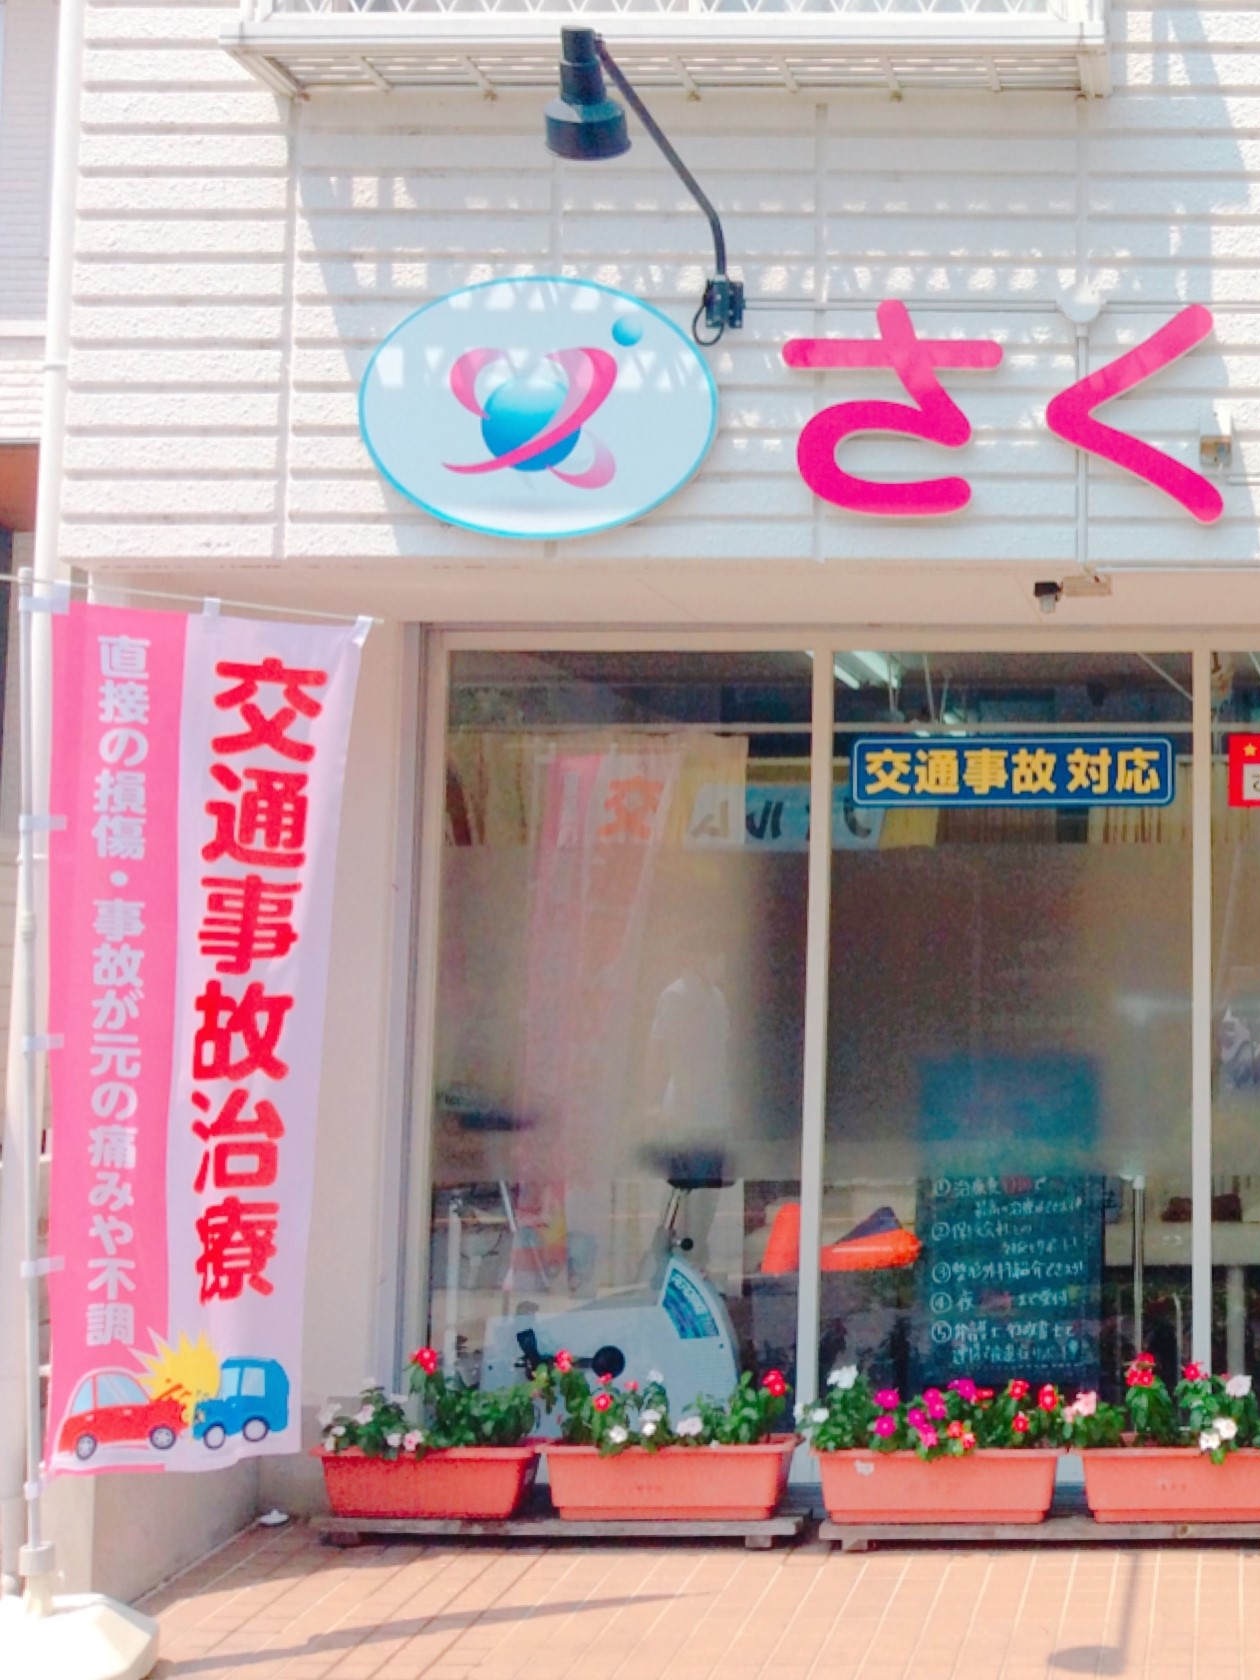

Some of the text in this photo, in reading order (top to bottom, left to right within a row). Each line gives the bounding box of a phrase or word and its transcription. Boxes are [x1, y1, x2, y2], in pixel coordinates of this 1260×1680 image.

[86, 633, 151, 1347] 直接の損傷・事故が元の痛みや不調
[192, 657, 328, 1304] 交通事故治療
